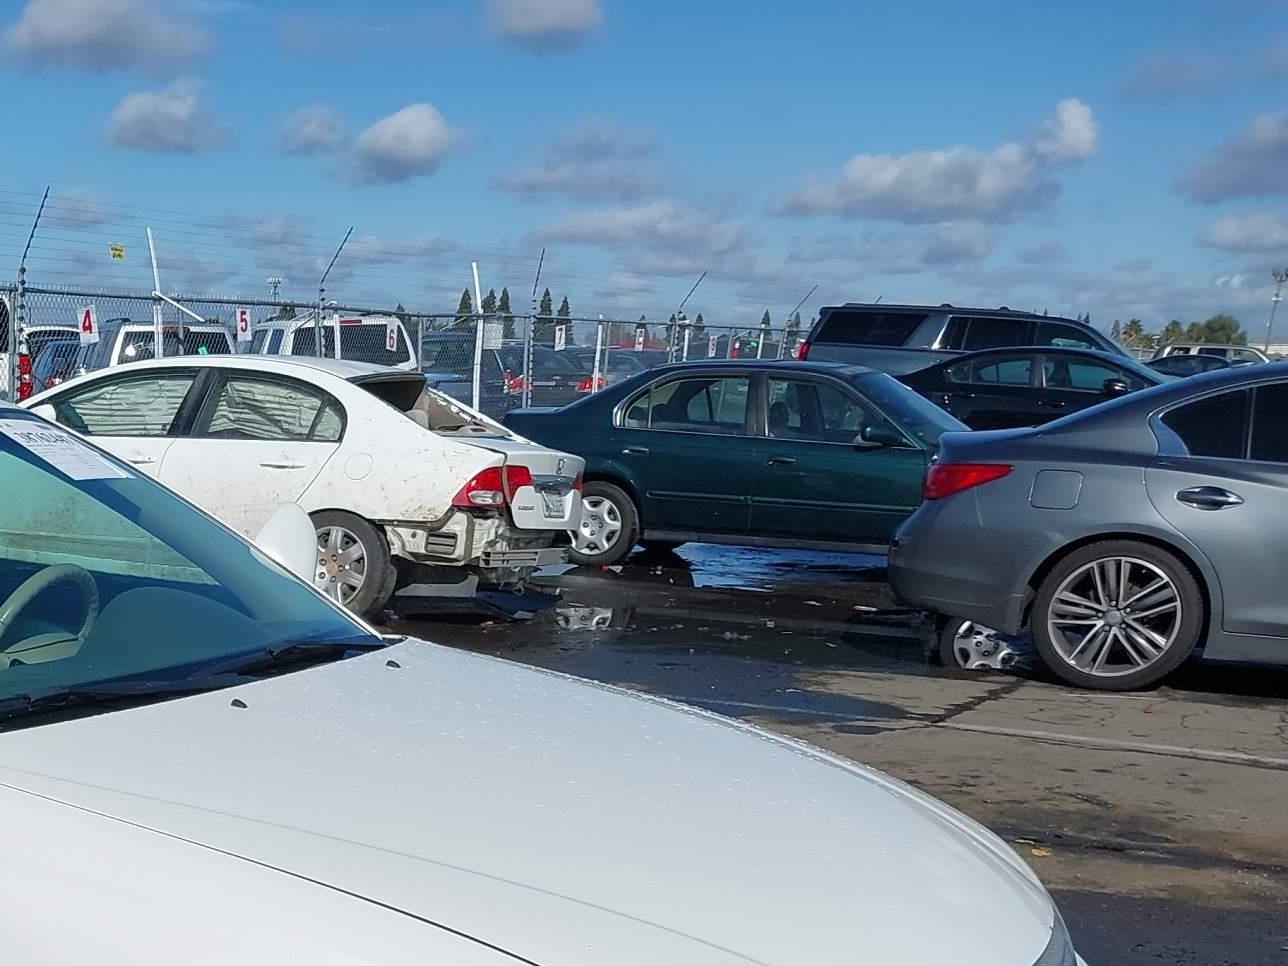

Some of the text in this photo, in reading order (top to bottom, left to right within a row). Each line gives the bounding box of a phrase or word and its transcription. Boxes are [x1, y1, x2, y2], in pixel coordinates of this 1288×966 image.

[82, 308, 93, 335] 4
[239, 310, 249, 333] 5
[388, 328, 396, 349] 6
[556, 327, 564, 349] 7
